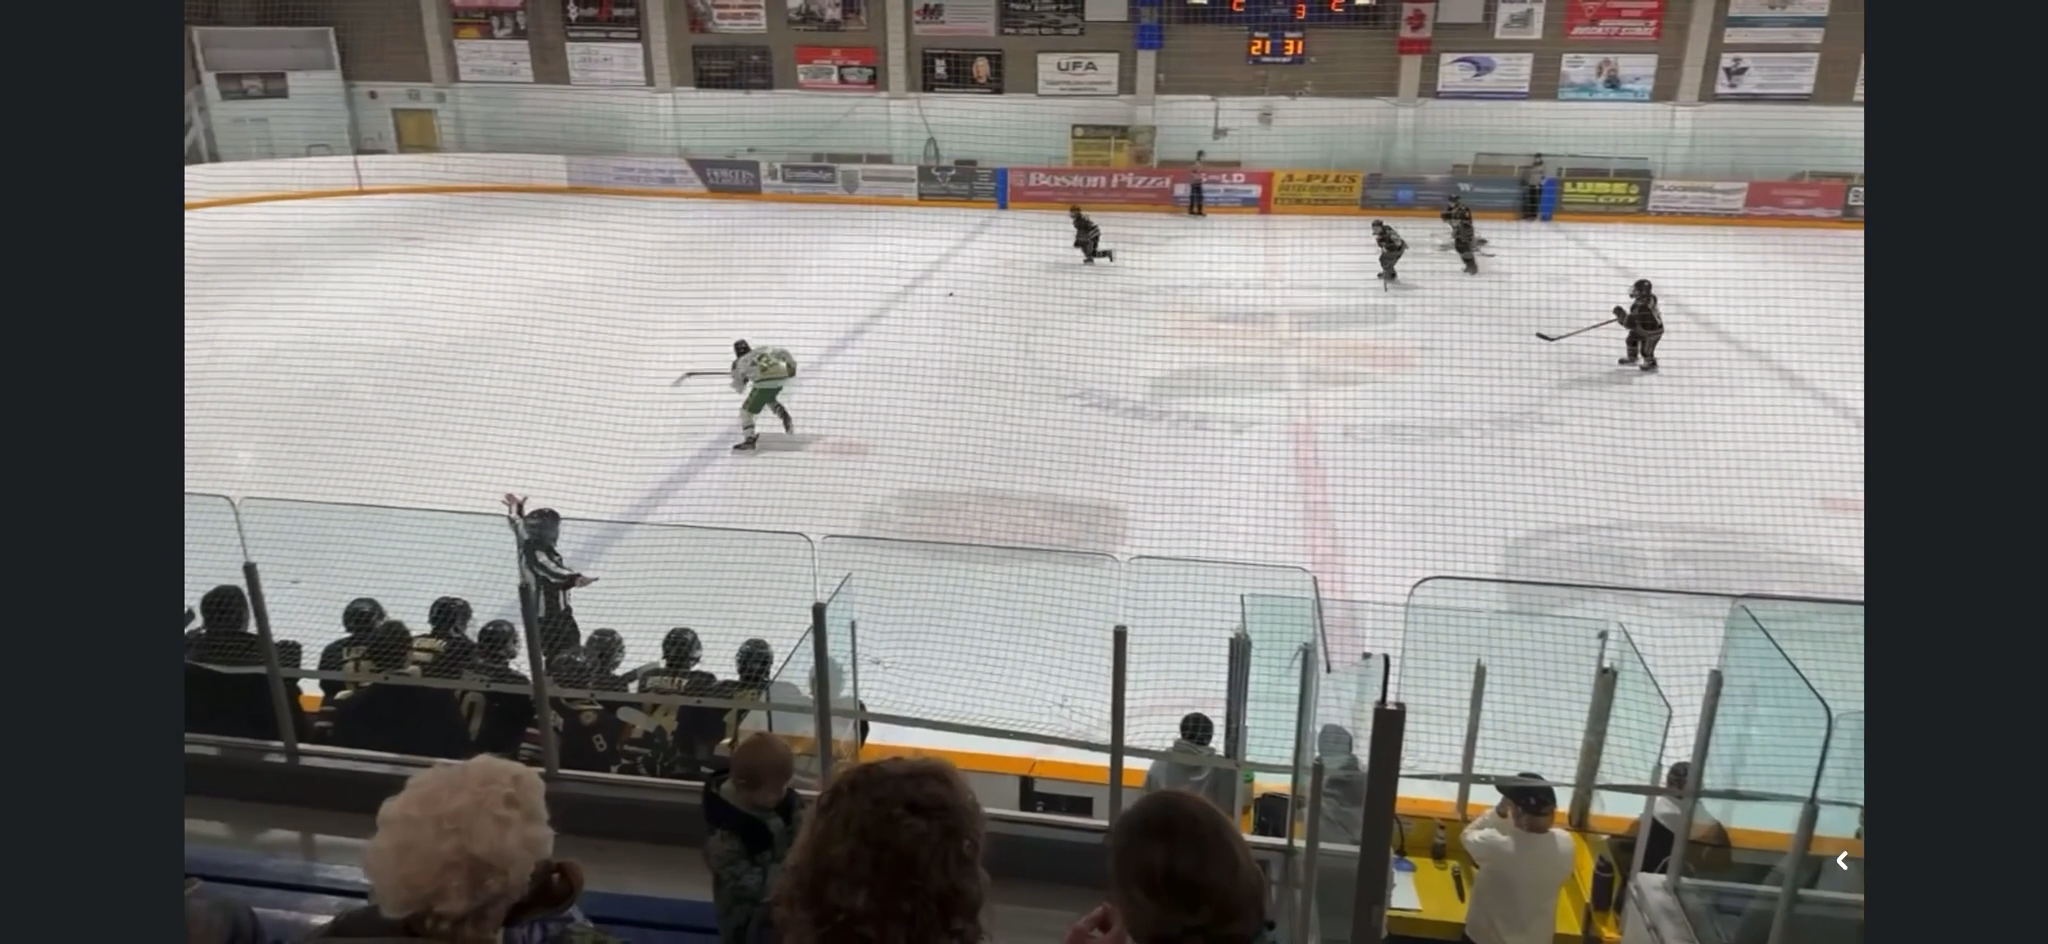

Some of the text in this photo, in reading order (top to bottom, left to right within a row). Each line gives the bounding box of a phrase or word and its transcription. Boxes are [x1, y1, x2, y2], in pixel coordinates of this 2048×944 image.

[1250, 40, 1304, 55] 21 31
[1056, 61, 1098, 72] UFA
[1028, 171, 1172, 189] Boston Pizza
[1281, 174, 1358, 184] A-PLUS
[1564, 182, 1629, 194] LUBE
[592, 733, 608, 753] 8
